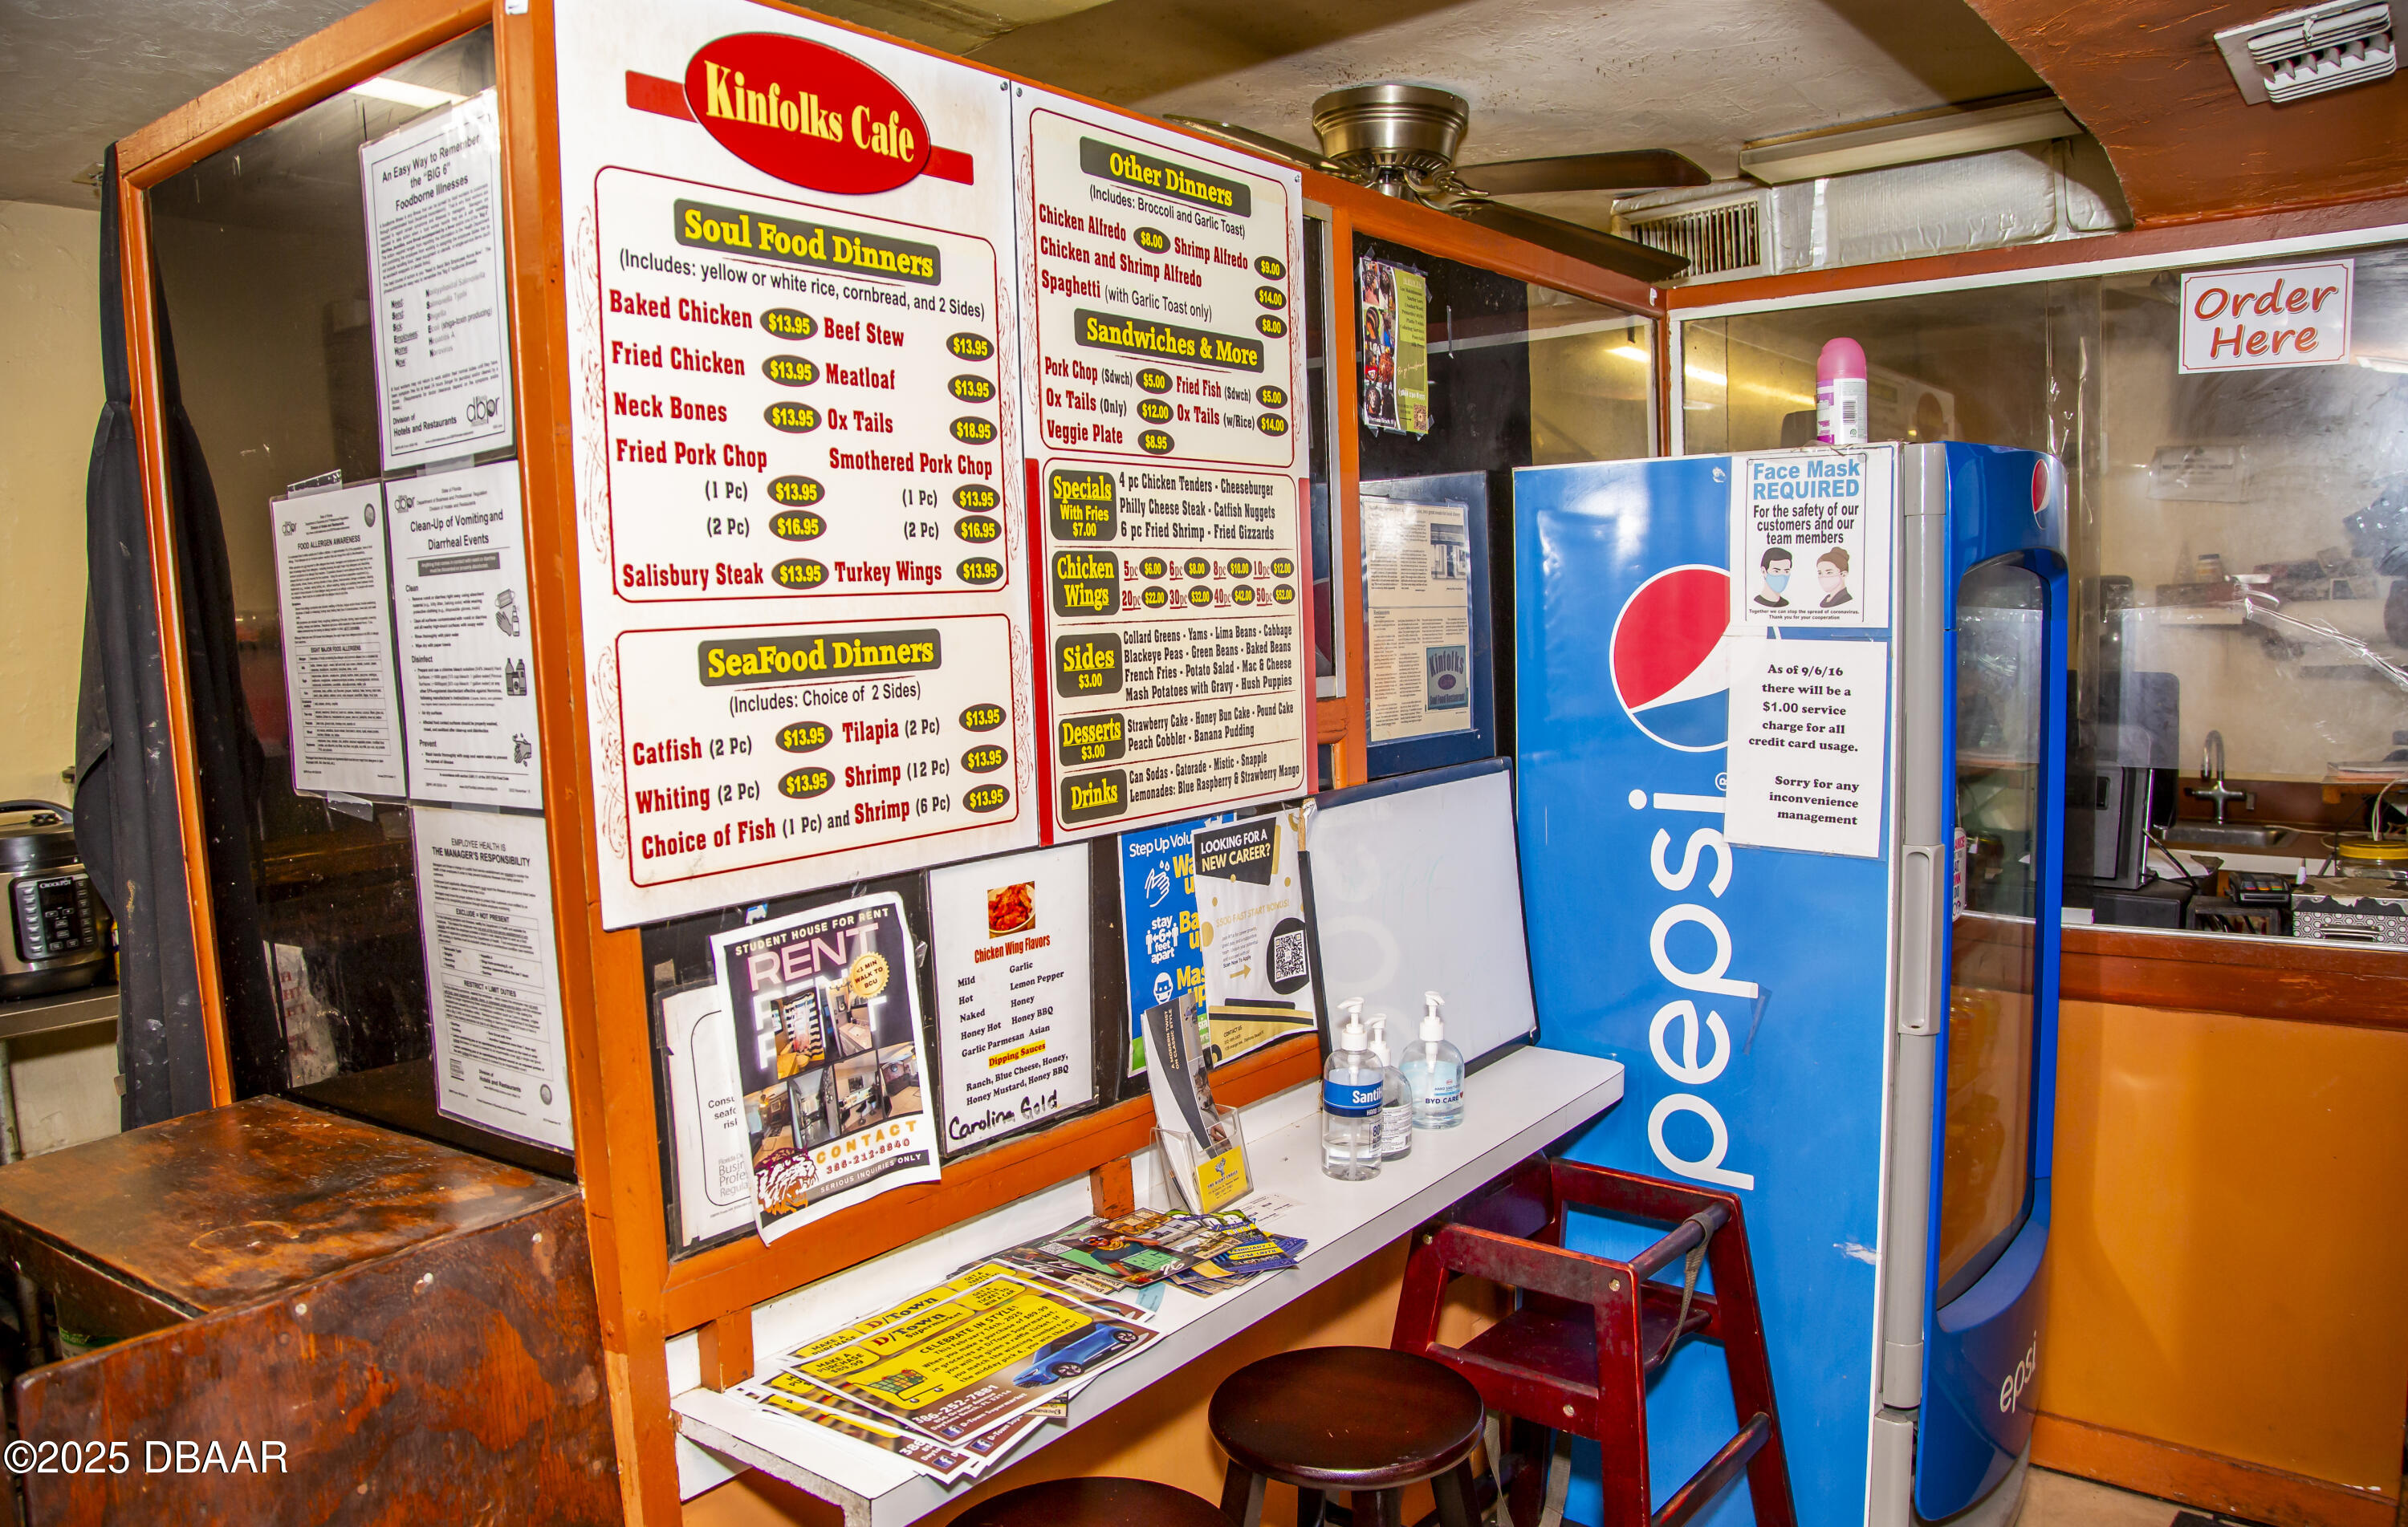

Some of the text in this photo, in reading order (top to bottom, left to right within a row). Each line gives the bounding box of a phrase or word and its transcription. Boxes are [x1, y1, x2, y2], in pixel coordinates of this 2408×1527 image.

[705, 60, 914, 162] Kinfolks Cafe
[382, 170, 392, 183] An
[393, 163, 410, 179] Easy
[413, 158, 428, 171] Way
[430, 152, 437, 161] to
[1109, 152, 1233, 207] Other Dinners
[396, 175, 468, 211] Foodborne Illnesses
[410, 176, 421, 189] the
[1090, 184, 1245, 240] (Includes: Broccoli and Garlic Toast)
[684, 209, 934, 278] Soul Food Dinners
[620, 248, 985, 320] (Includes: yellow or white rice, cornbread, and 2 Sides)
[2194, 278, 2338, 320] Order
[610, 289, 988, 357] Baked Chicken $13.95 Beef Stew $13.95
[1087, 318, 1257, 366] Sandwiches & More
[2211, 323, 2318, 359] Here
[394, 416, 457, 437] Hotels and Restaurants
[1047, 420, 1167, 449] Veggie Plate $8.95
[829, 448, 992, 479] Smothered Pork Chop
[1753, 458, 1861, 481] Face Mask
[1054, 475, 1112, 504] Specials
[1753, 479, 1859, 500] REQUIRED
[411, 509, 503, 532] Clean-Up of Vomiting and
[1060, 504, 1109, 522] With Fries
[1120, 497, 1275, 520] Philly Cheese Steak Catfish Nuggets
[1754, 502, 1859, 519] For the safety of our
[298, 535, 360, 550] FOOD ALLERGEN AWARENESS
[429, 534, 489, 550] Diarrheal Events
[1073, 522, 1096, 537] $7.00
[623, 561, 942, 590] Salisbury Steak Turkey Wings
[1057, 554, 1114, 579] Chicken
[1064, 585, 1109, 611] Wings
[1124, 624, 1292, 644] Collard Greens Yams Lima Beans Cabbage
[707, 639, 934, 678] SeaFood Dinners
[1064, 643, 1114, 670] Sides
[1429, 651, 1463, 677] Kinfolks
[1079, 672, 1102, 688] $3.00
[1767, 664, 1844, 677] As of 9/6/16
[1763, 701, 1846, 716] $1.00 service
[843, 719, 899, 744] Tilapia
[1063, 718, 1121, 745] Desserts
[633, 737, 702, 766] Catfish
[1071, 778, 1117, 810] Drinks
[451, 838, 506, 851] EMPLOYEE HEALTH IS
[1129, 838, 1169, 858] Step Up
[1201, 829, 1267, 854] LOOKING FOR A
[432, 847, 443, 856] THE
[480, 852, 530, 867] RESPONSIBILITY
[1202, 843, 1270, 872] NEW CAREER?
[735, 908, 889, 956] STUDENT HOUSE FOR RENT
[1152, 915, 1173, 930] stay
[747, 923, 879, 991] RENT
[974, 934, 1050, 964] Chicken Wing Flavors
[1151, 949, 1175, 965] apart
[1155, 941, 1170, 952] feet
[855, 972, 872, 983] WALK
[864, 979, 877, 988] BCU
[1010, 970, 1064, 991] Lemon Pepper
[1628, 789, 1759, 1191] pepsi
[989, 1042, 1045, 1067] Dipping Sauces
[1443, 1095, 1459, 1103] CARE
[949, 1089, 1058, 1140] Carolina Gold
[817, 1120, 917, 1164] CONTACT
[820, 1154, 921, 1193] SERIOUS INQUIRIES ONLY
